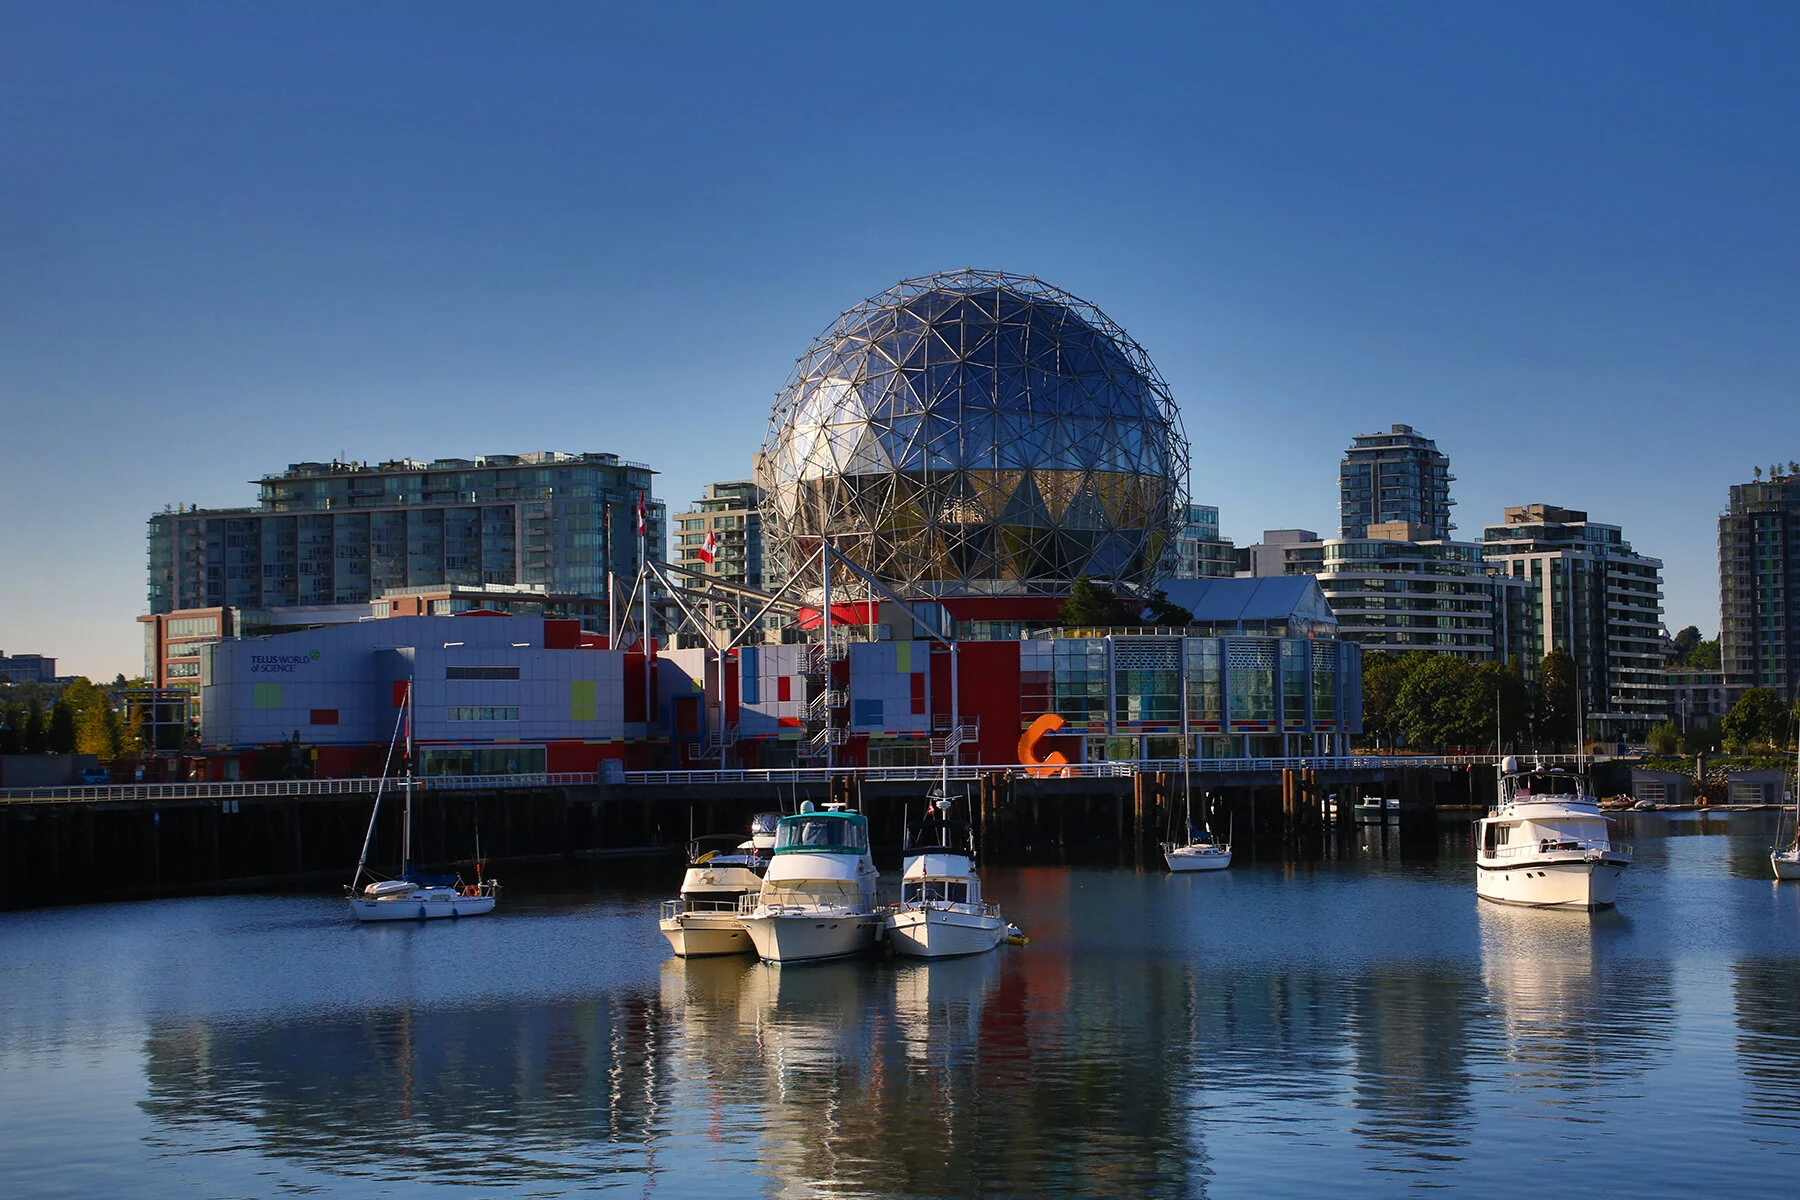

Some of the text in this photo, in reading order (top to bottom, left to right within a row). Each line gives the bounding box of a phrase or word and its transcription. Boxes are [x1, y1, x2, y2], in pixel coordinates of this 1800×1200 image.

[251, 655, 310, 664] TELUS WORLD
[251, 664, 294, 672] of SCIENCE
